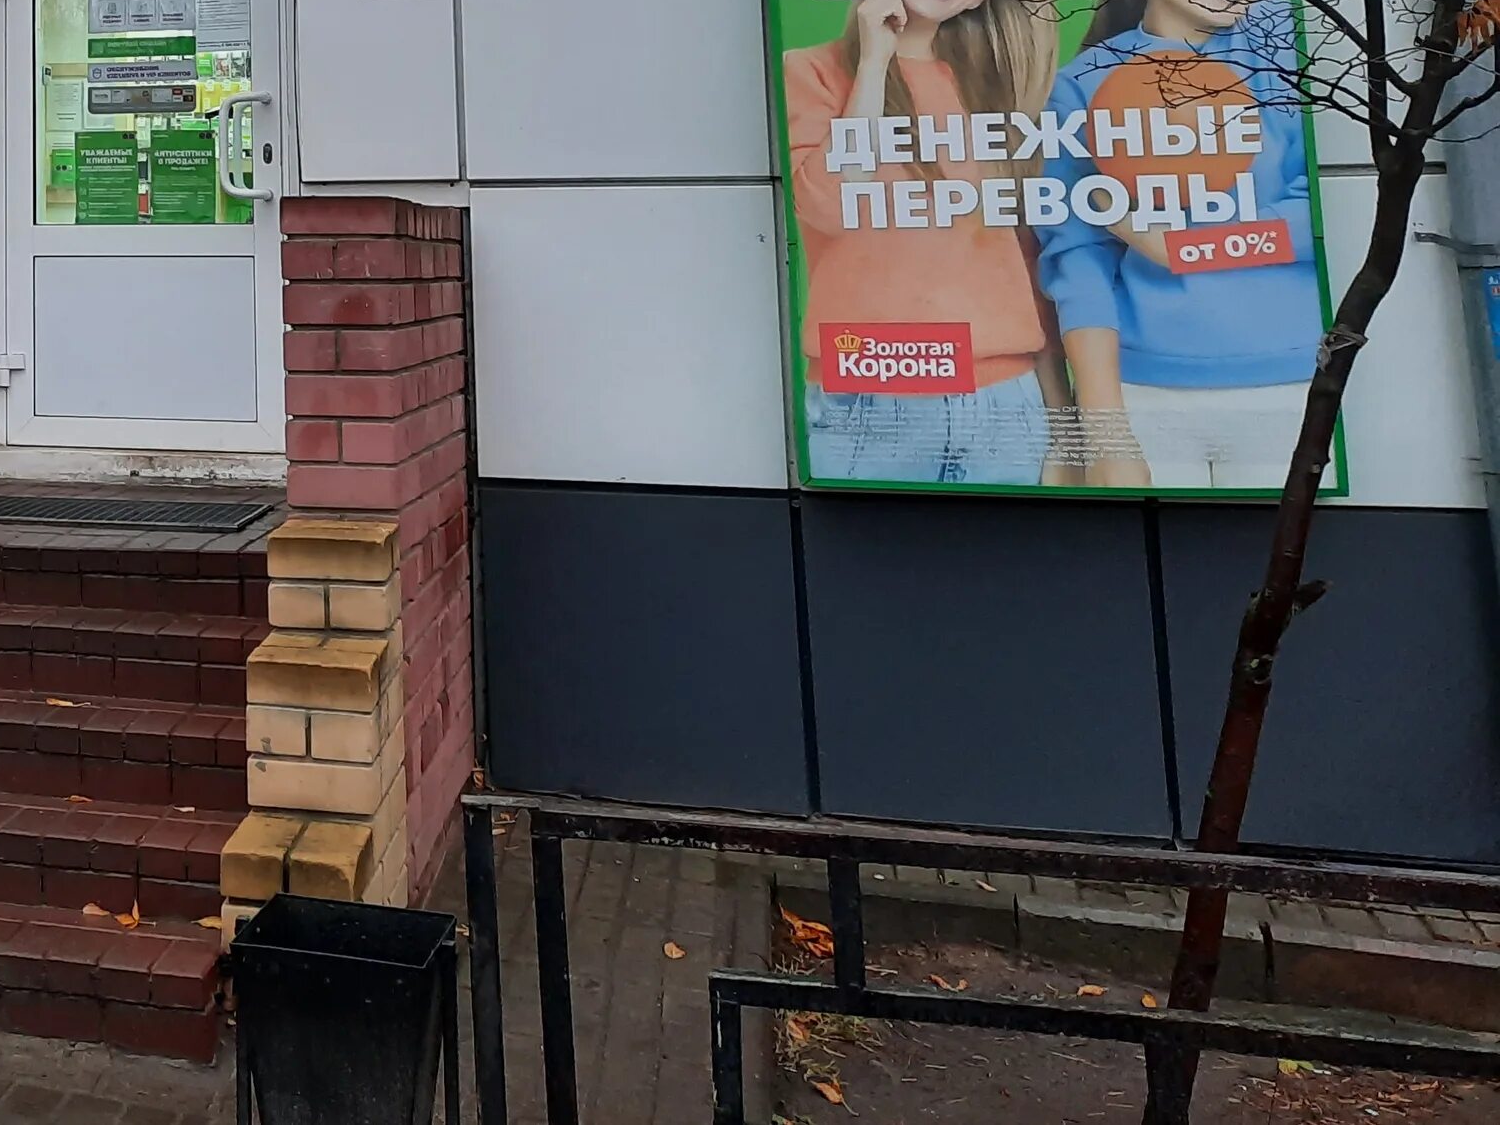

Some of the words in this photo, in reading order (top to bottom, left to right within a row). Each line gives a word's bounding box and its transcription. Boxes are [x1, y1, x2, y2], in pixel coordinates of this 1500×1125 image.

[825, 104, 1263, 172] ДЕНЕЖНЫЕ
[840, 172, 1258, 232] ПЕРЕВОДЫ
[838, 352, 956, 382] Корона
